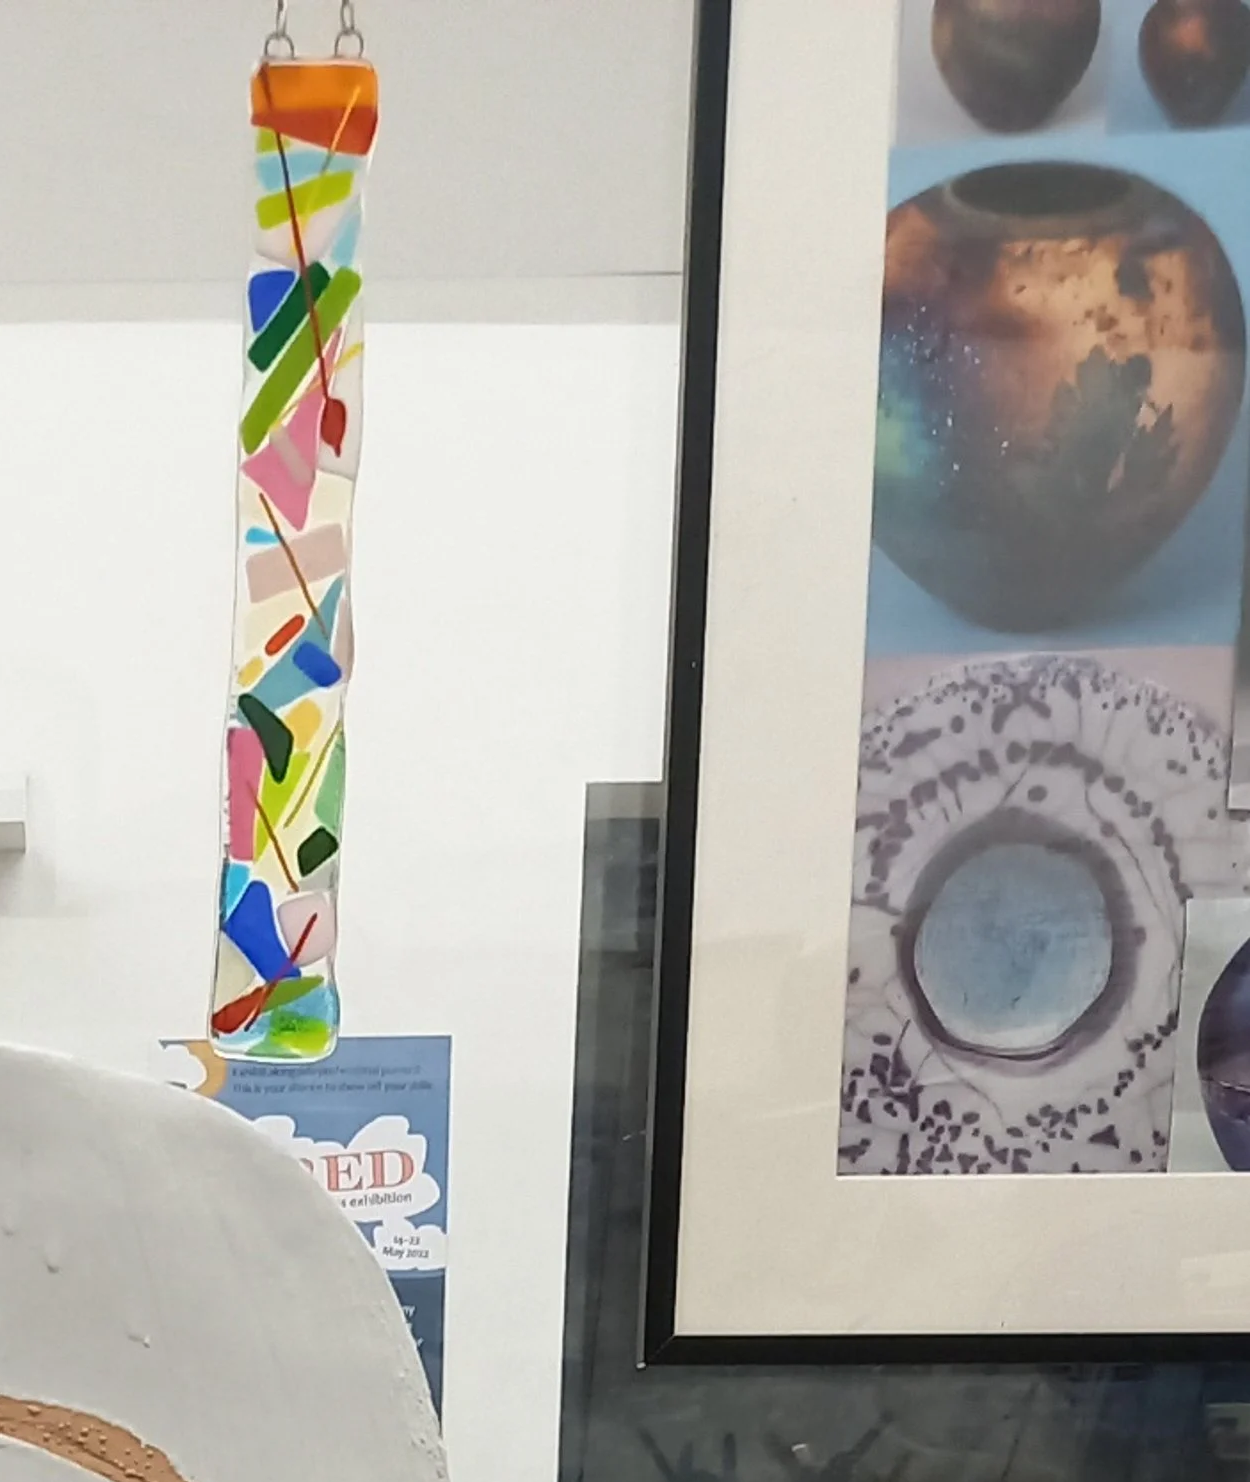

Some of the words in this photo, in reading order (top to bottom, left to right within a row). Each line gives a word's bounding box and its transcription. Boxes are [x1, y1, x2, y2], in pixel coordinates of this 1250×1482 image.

[299, 1149, 414, 1192] ED
[350, 1192, 412, 1208] exhibition
[382, 1246, 405, 1260] May
